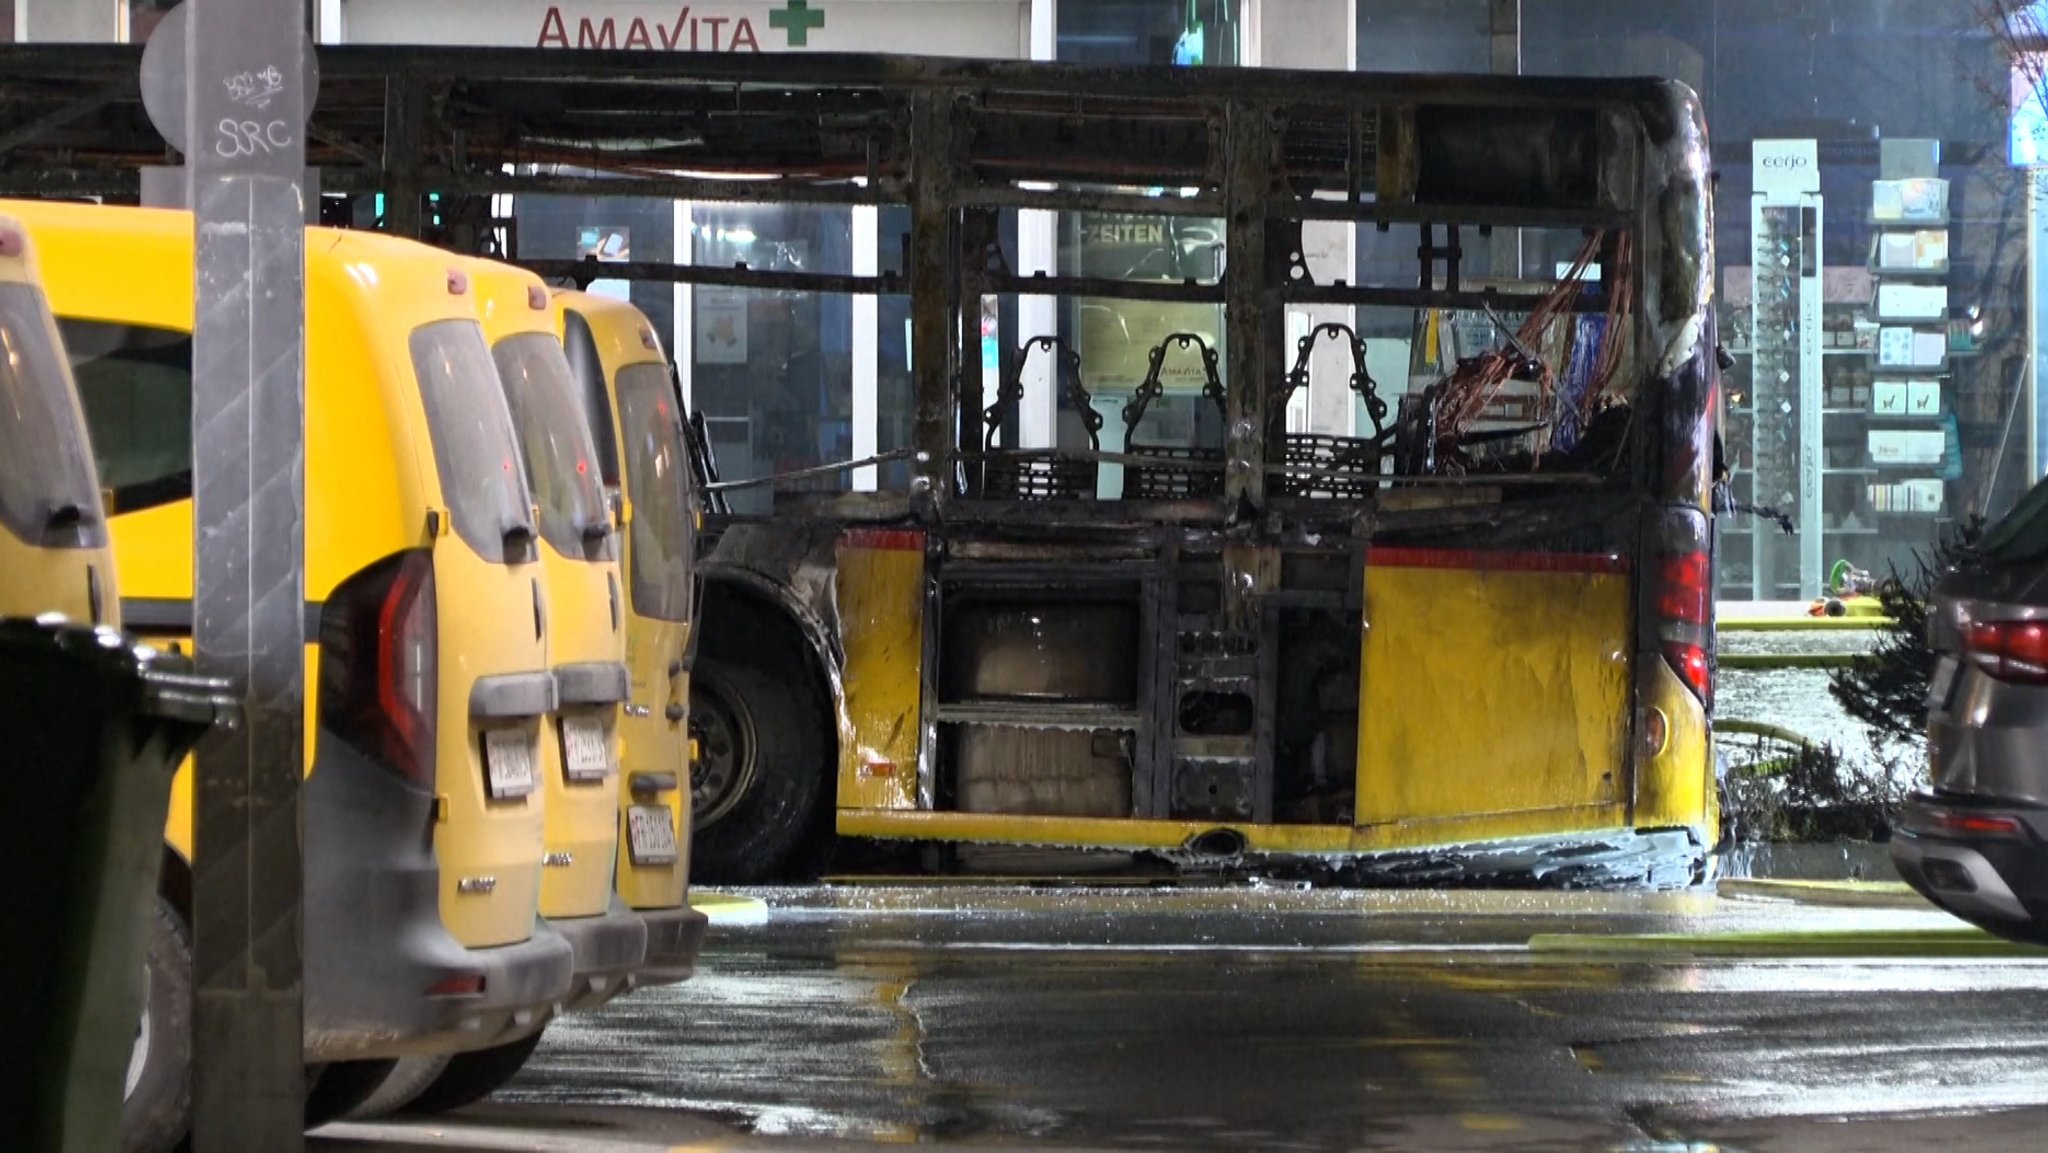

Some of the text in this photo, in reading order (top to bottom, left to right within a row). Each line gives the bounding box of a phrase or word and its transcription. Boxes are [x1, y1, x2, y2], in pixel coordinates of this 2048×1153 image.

[536, 6, 760, 51] AMAVITA
[216, 118, 291, 157] SRC
[1087, 223, 1163, 243] ZEITEN
